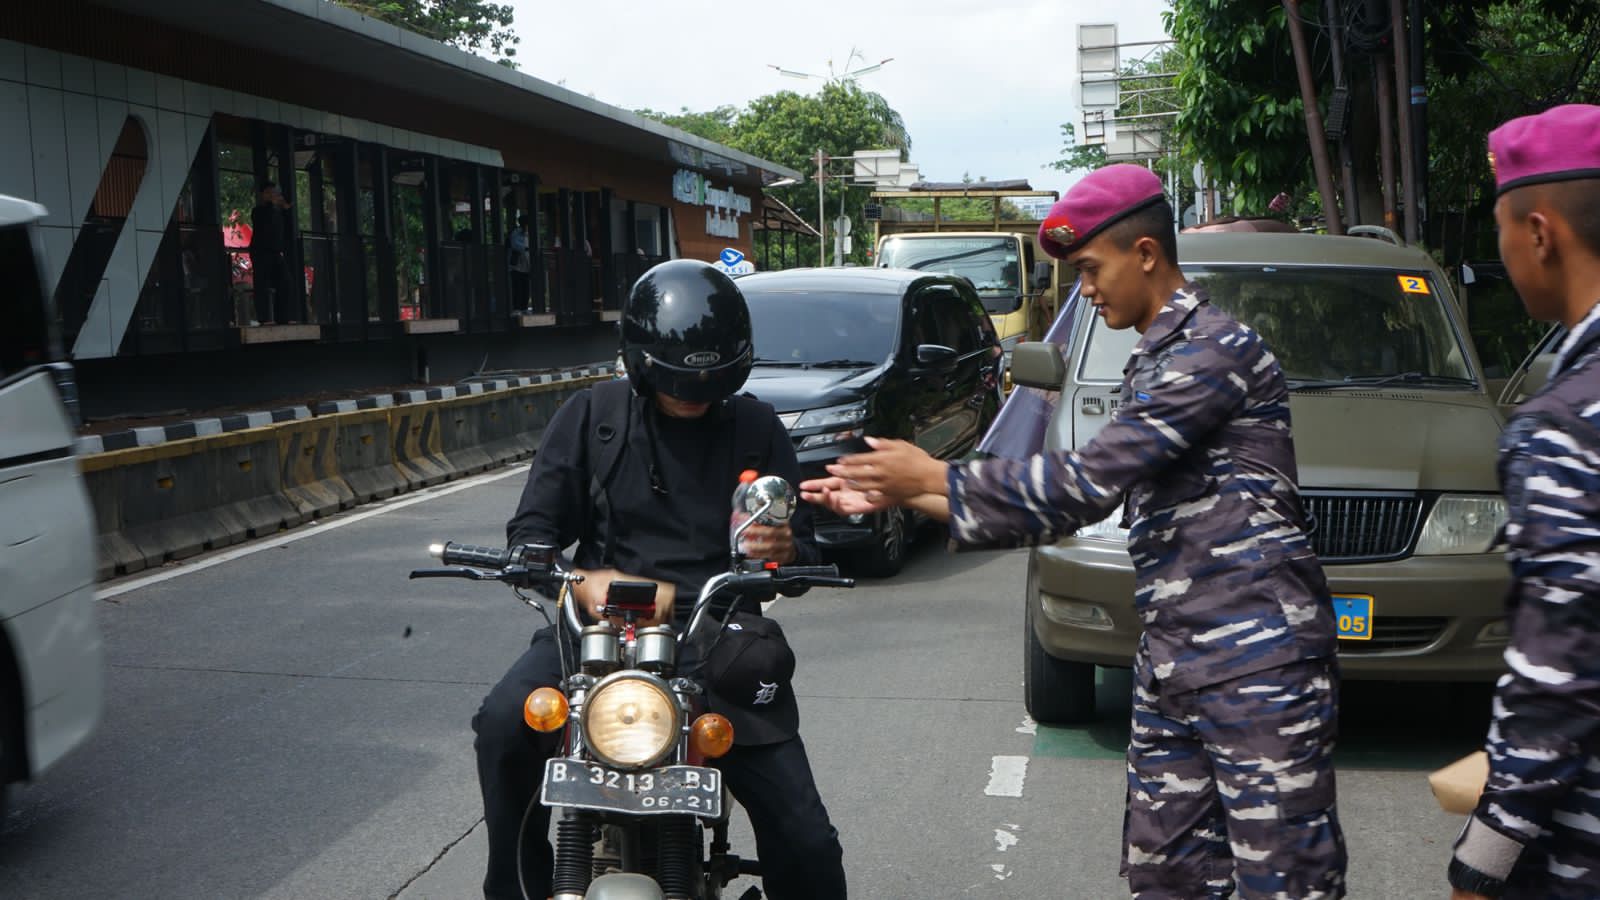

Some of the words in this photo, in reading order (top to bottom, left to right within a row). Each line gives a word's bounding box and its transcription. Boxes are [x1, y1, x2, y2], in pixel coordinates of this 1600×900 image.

[1407, 279, 1421, 290] 2
[1338, 615, 1365, 632] 05
[753, 681, 779, 705] D
[589, 766, 654, 791] 3213
[685, 771, 716, 792] BJ
